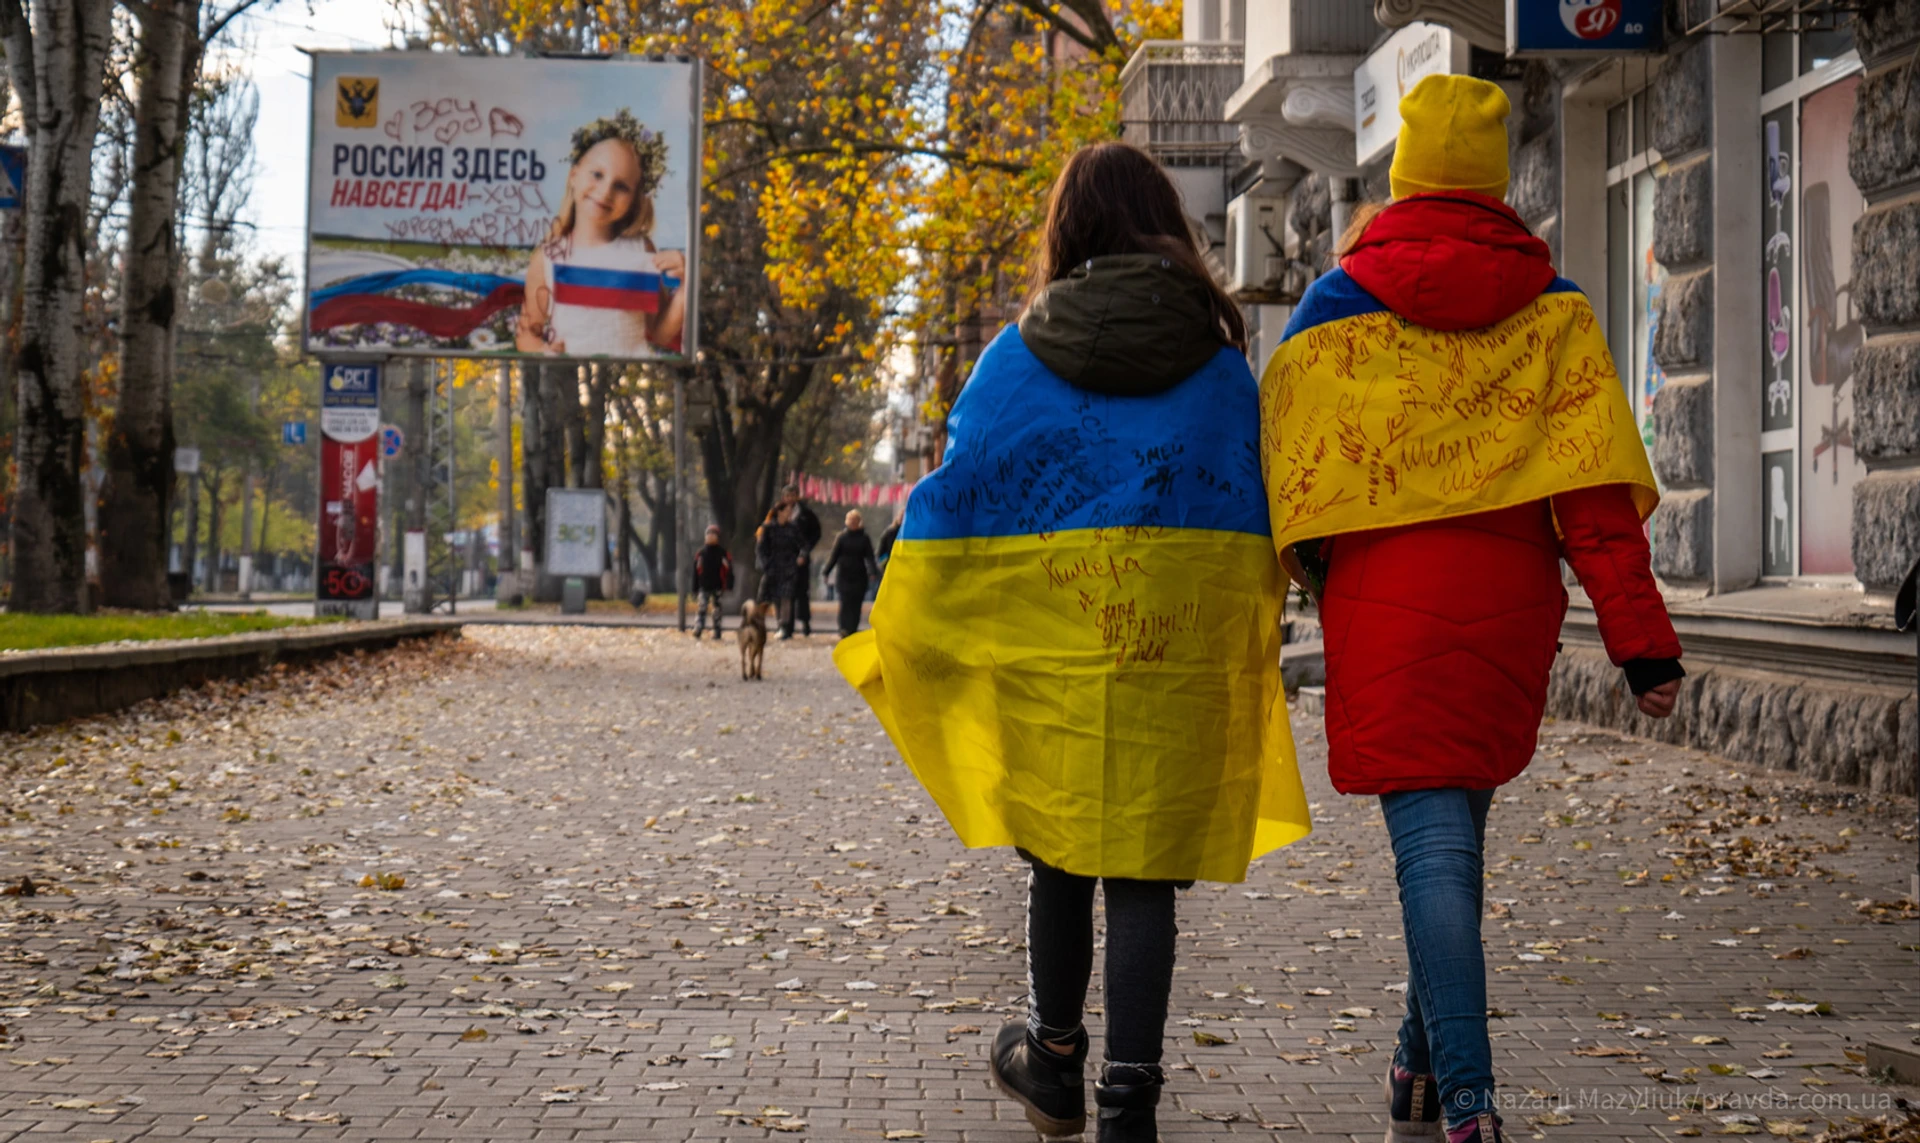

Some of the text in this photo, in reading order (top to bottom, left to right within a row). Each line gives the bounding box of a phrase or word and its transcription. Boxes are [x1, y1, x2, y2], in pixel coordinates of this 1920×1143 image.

[332, 144, 546, 184] РОССИЯ ЗДЕСЬ
[330, 179, 467, 212] НАВСЕГДА!
